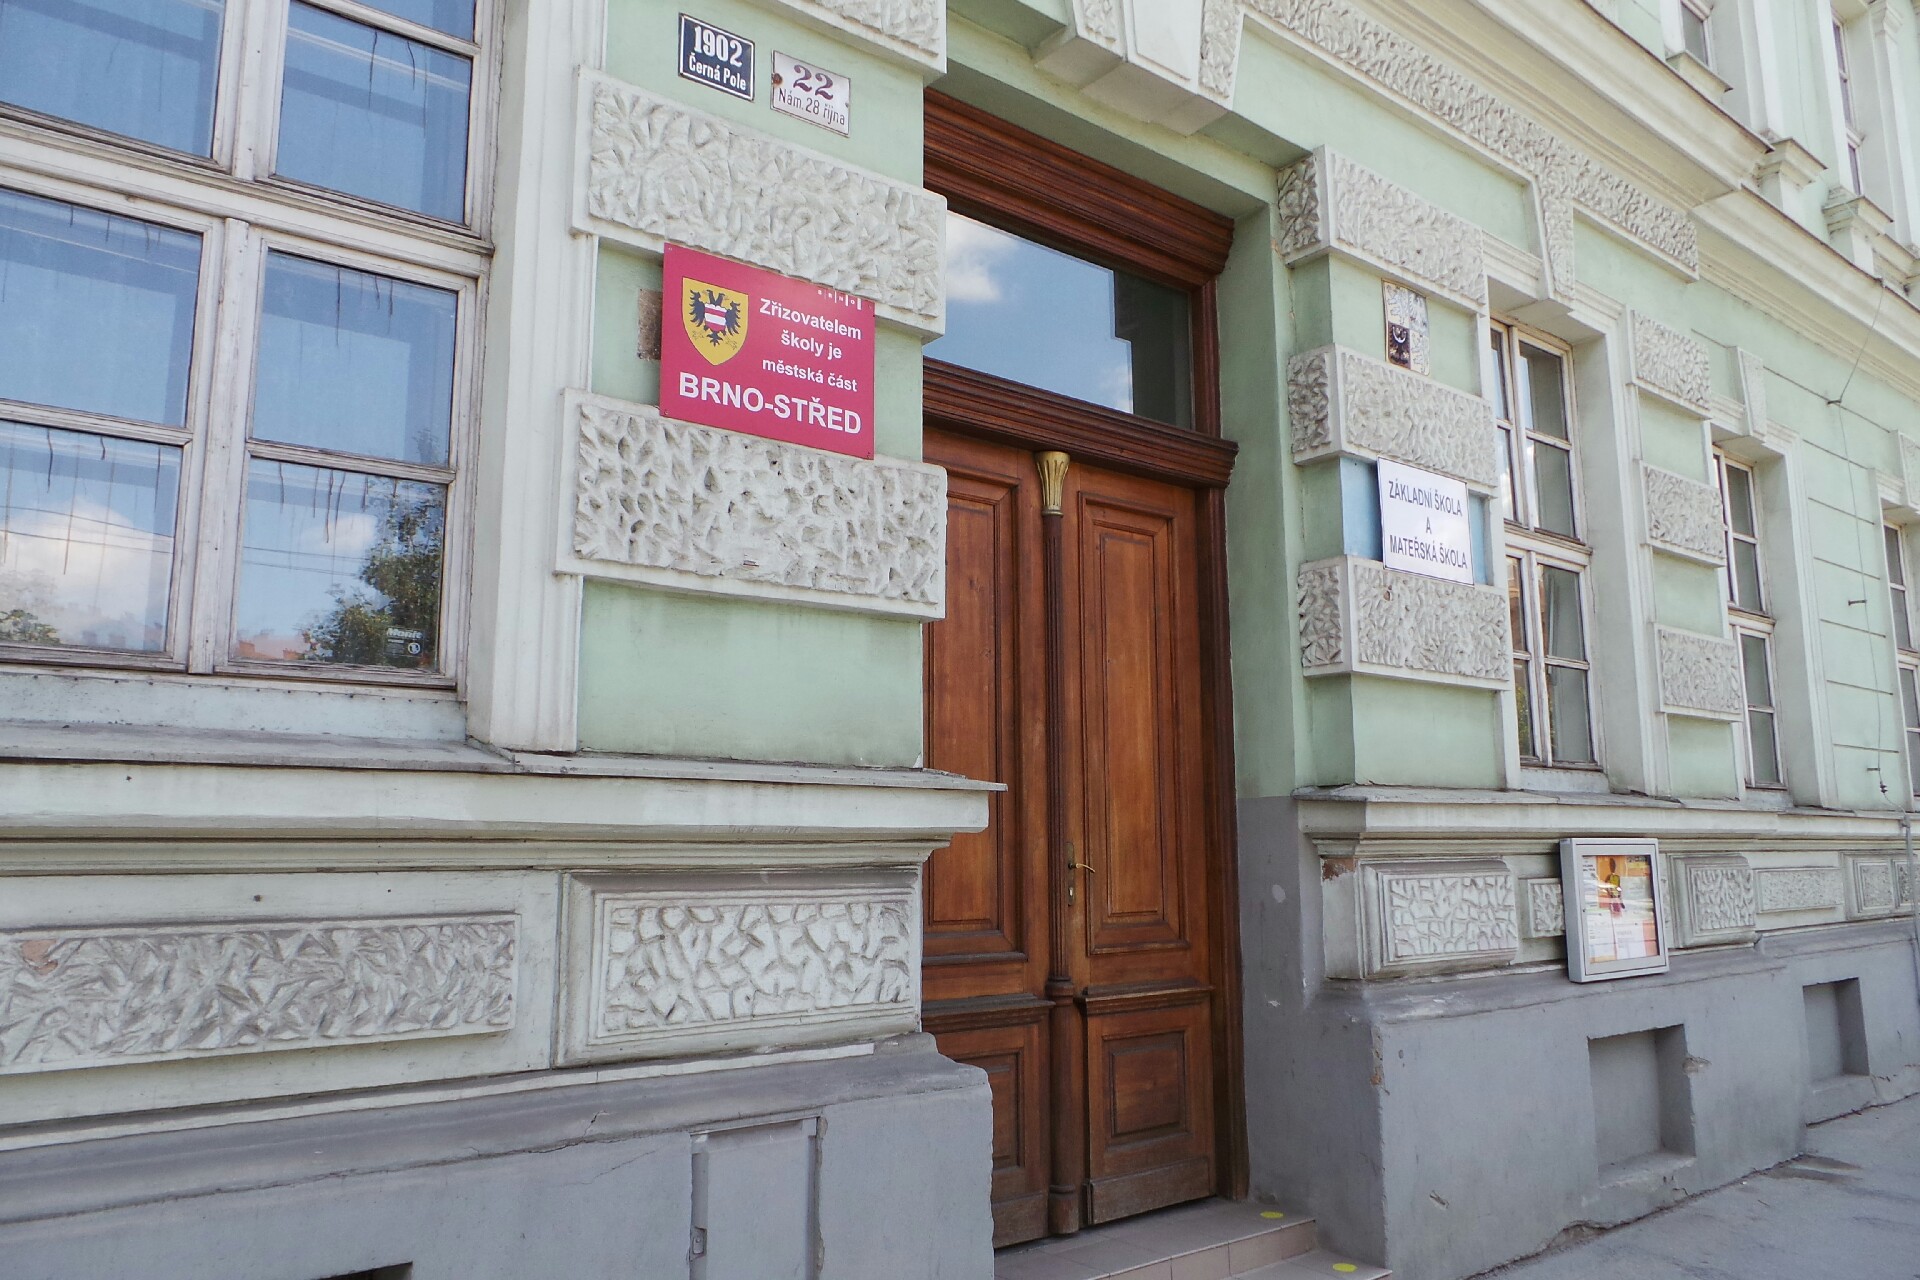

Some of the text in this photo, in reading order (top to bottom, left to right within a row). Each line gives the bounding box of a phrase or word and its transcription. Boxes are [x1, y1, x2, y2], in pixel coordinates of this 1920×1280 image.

[694, 26, 743, 68] 1902
[689, 52, 746, 91] Černá Pole
[793, 64, 834, 100] 22
[778, 88, 804, 111] Nám.
[805, 99, 820, 115] 28
[759, 298, 862, 340] Zřizovatelem
[781, 329, 842, 361] školy je
[762, 359, 858, 392] městská část
[679, 371, 861, 434] BRNO-STŘED
[1388, 478, 1463, 517] ZÁKLADNÍ ŠKOLA
[1425, 516, 1432, 534] A
[1389, 535, 1468, 569] MATEŘSKÁ ŠKOLA
